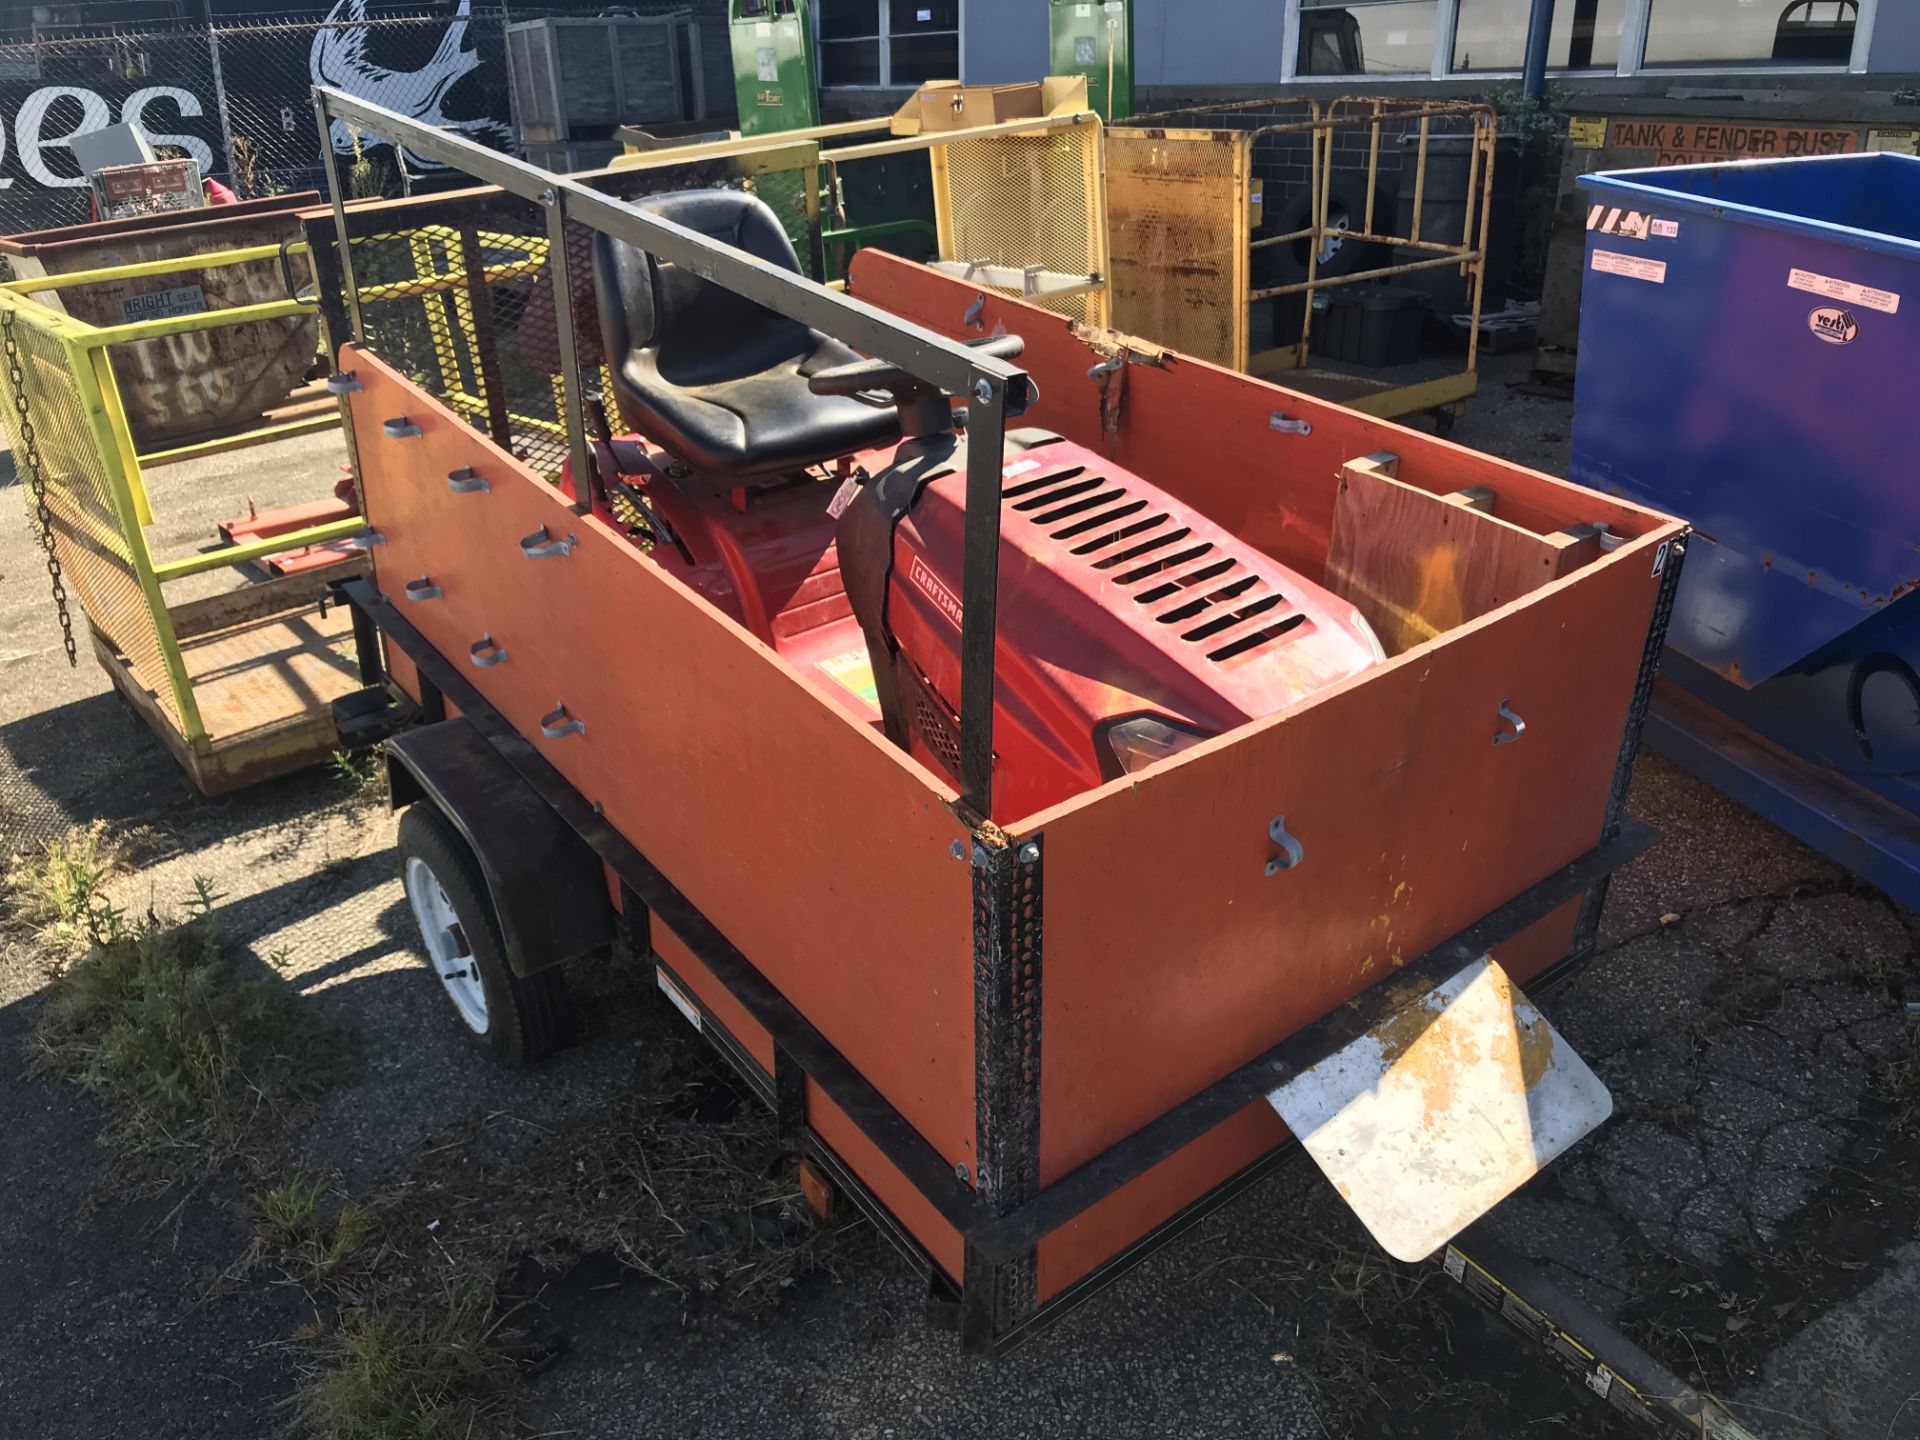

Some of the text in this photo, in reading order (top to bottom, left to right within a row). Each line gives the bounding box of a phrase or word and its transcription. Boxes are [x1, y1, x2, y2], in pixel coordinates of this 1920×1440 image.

[0, 86, 214, 189] es
[1614, 123, 1666, 147] TANK
[1672, 126, 1685, 148] &
[1693, 126, 1776, 153] FENDER
[1784, 130, 1851, 154] DUST
[123, 289, 200, 314] WRIGHT SELF
[1652, 544, 1666, 576] 2
[915, 566, 963, 624] CRAFTSMA
